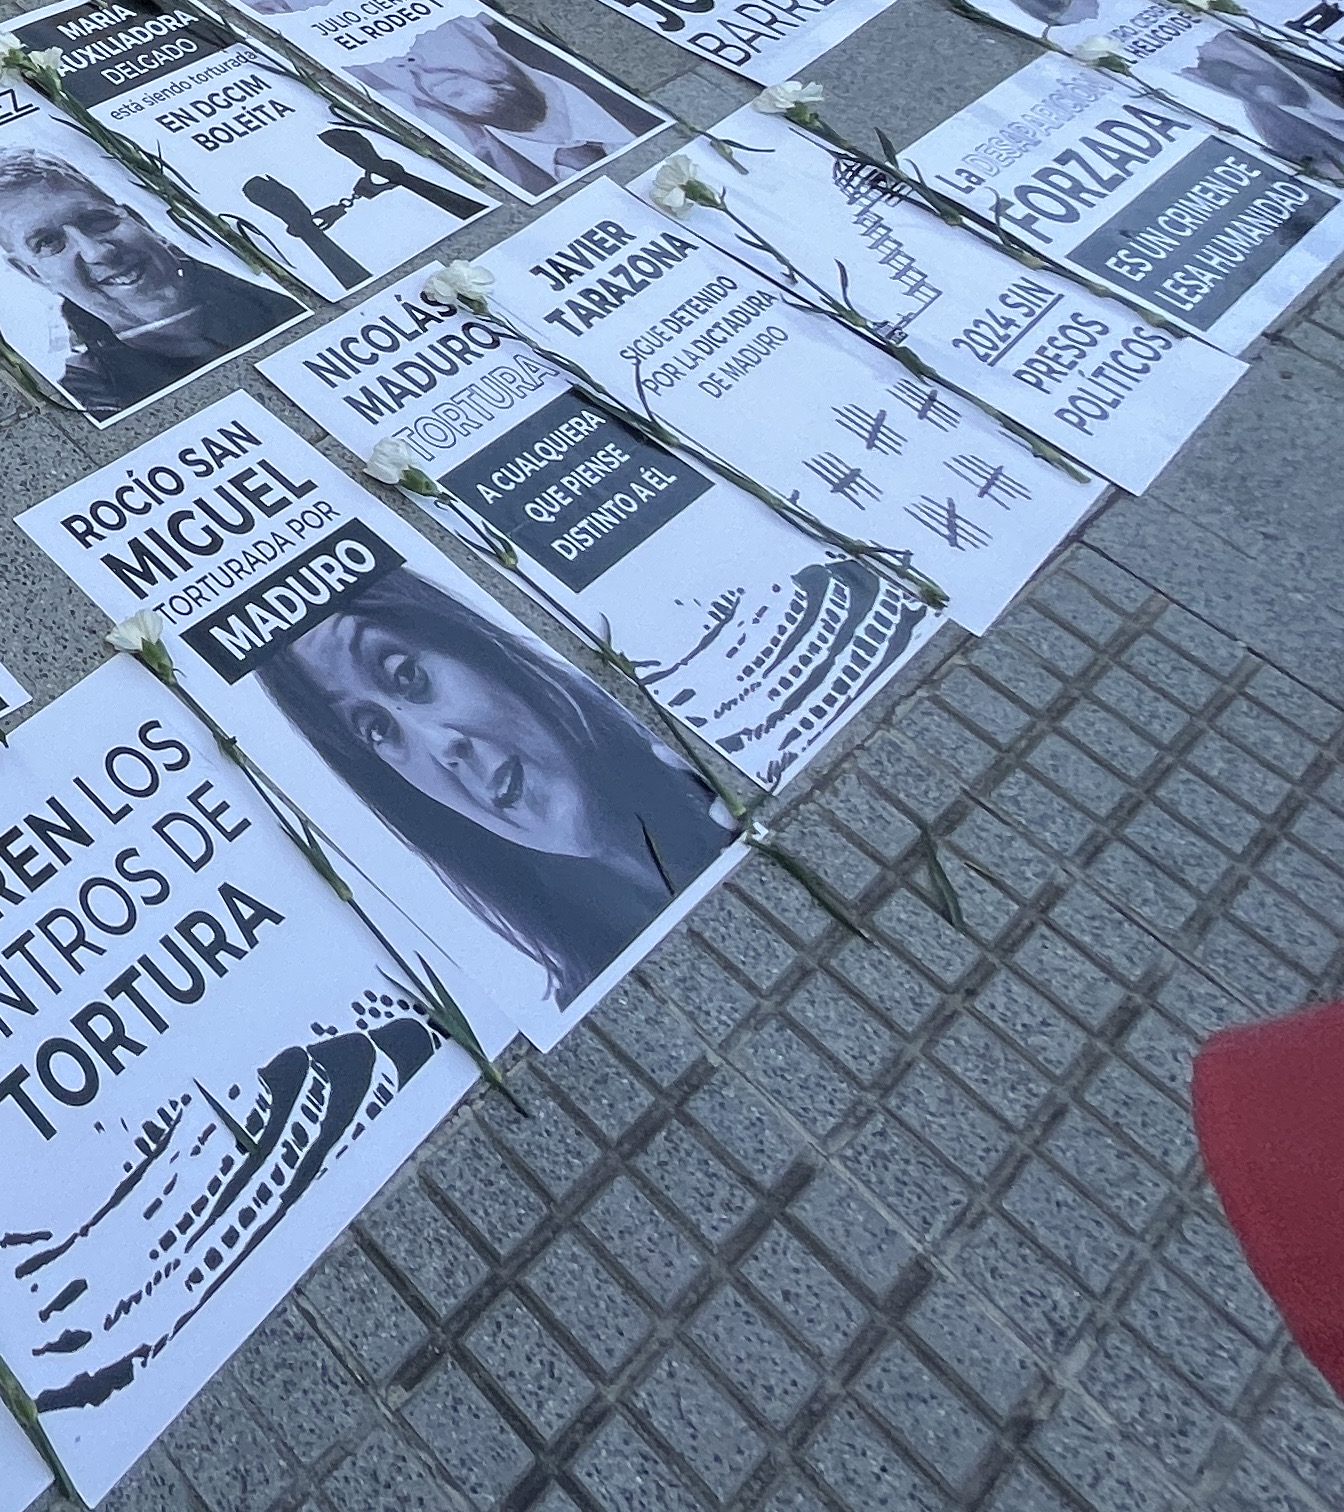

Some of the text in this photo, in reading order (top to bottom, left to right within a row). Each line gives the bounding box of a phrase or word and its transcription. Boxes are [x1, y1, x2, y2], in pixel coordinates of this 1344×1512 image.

[100, 38, 198, 85] DELGADO
[334, 32, 368, 50] EL
[360, 2, 432, 39] RODEO
[110, 49, 258, 120] está siendo torturada
[153, 73, 271, 136] EN DGCIM
[191, 98, 297, 154] BOLEÍTA
[935, 167, 988, 195] La
[1003, 103, 1192, 246] FORZADA
[1104, 155, 1262, 282] ES UN CRIMEN DE
[528, 218, 636, 292] JAVIER
[544, 230, 700, 339] TARAZONA
[1152, 180, 1311, 313] LESA HUMANIDAD
[301, 291, 458, 388] NICOLÁS
[619, 274, 740, 366] SIGUE DETENIDO
[642, 290, 781, 396] POR LA DICTADURA
[697, 325, 790, 400] DE MADURO
[951, 276, 1055, 365] 2024 SIN
[1012, 311, 1111, 396] PRESOS
[342, 322, 503, 426] MADURO
[393, 352, 560, 464] TORTURA
[1054, 324, 1175, 436] POLÍTICOS
[60, 419, 264, 550] ROCÍO SAN
[475, 408, 607, 506] A CUALQUIERA
[524, 442, 632, 526] QUE PIENSE
[100, 457, 320, 599] MIGUEL
[154, 500, 342, 626] TORTURADA POR
[550, 466, 678, 563] DISTINTO ÉL
[209, 538, 378, 661] MADURO
[71, 718, 195, 825] LOS
[150, 780, 255, 877] DE
